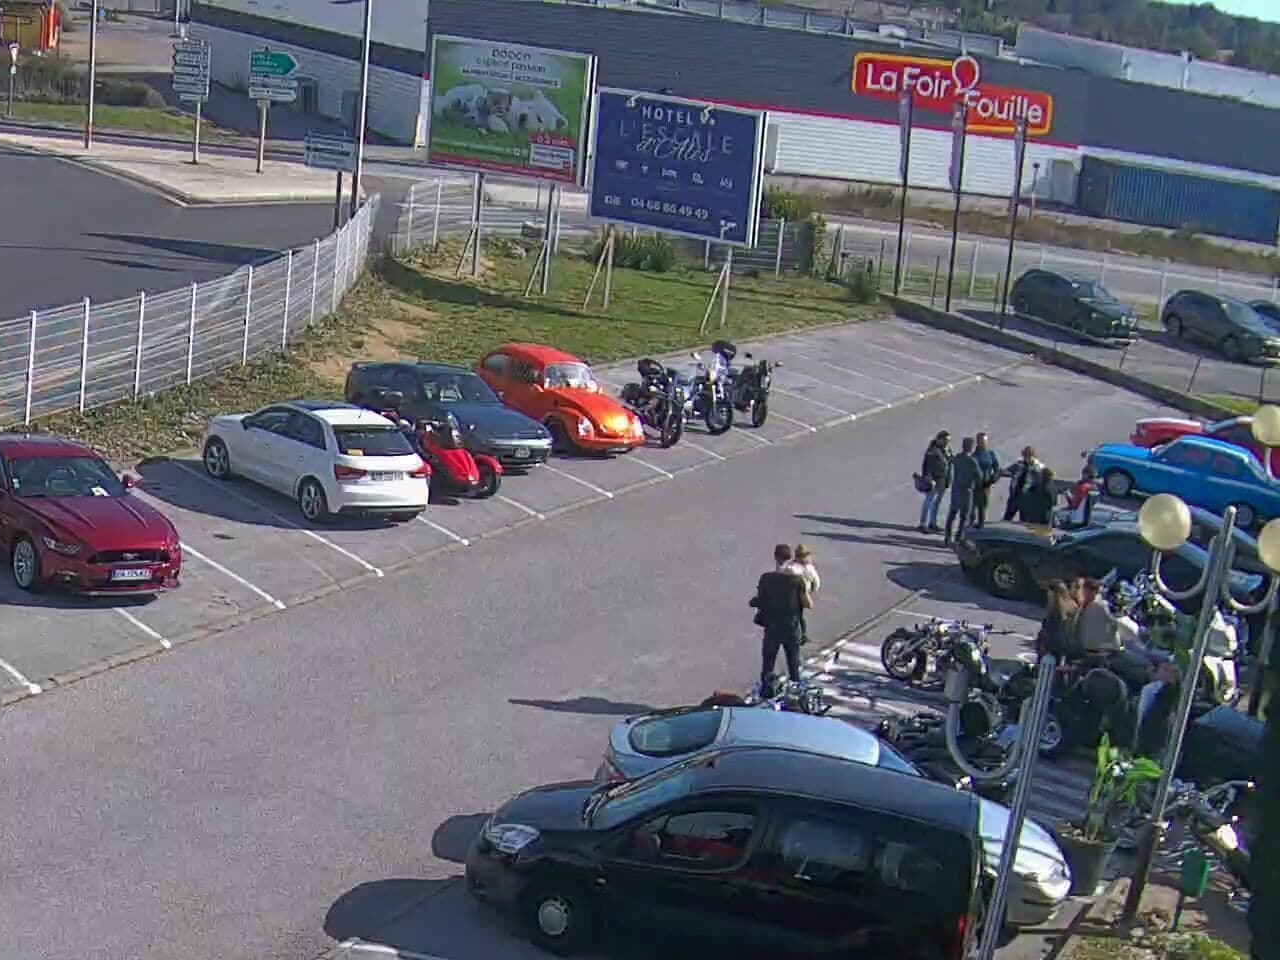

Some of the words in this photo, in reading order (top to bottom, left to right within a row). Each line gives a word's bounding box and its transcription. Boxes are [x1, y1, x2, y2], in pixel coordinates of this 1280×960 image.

[866, 63, 897, 91] La
[642, 105, 693, 125] HOTEL
[963, 88, 1043, 124] Fouille
